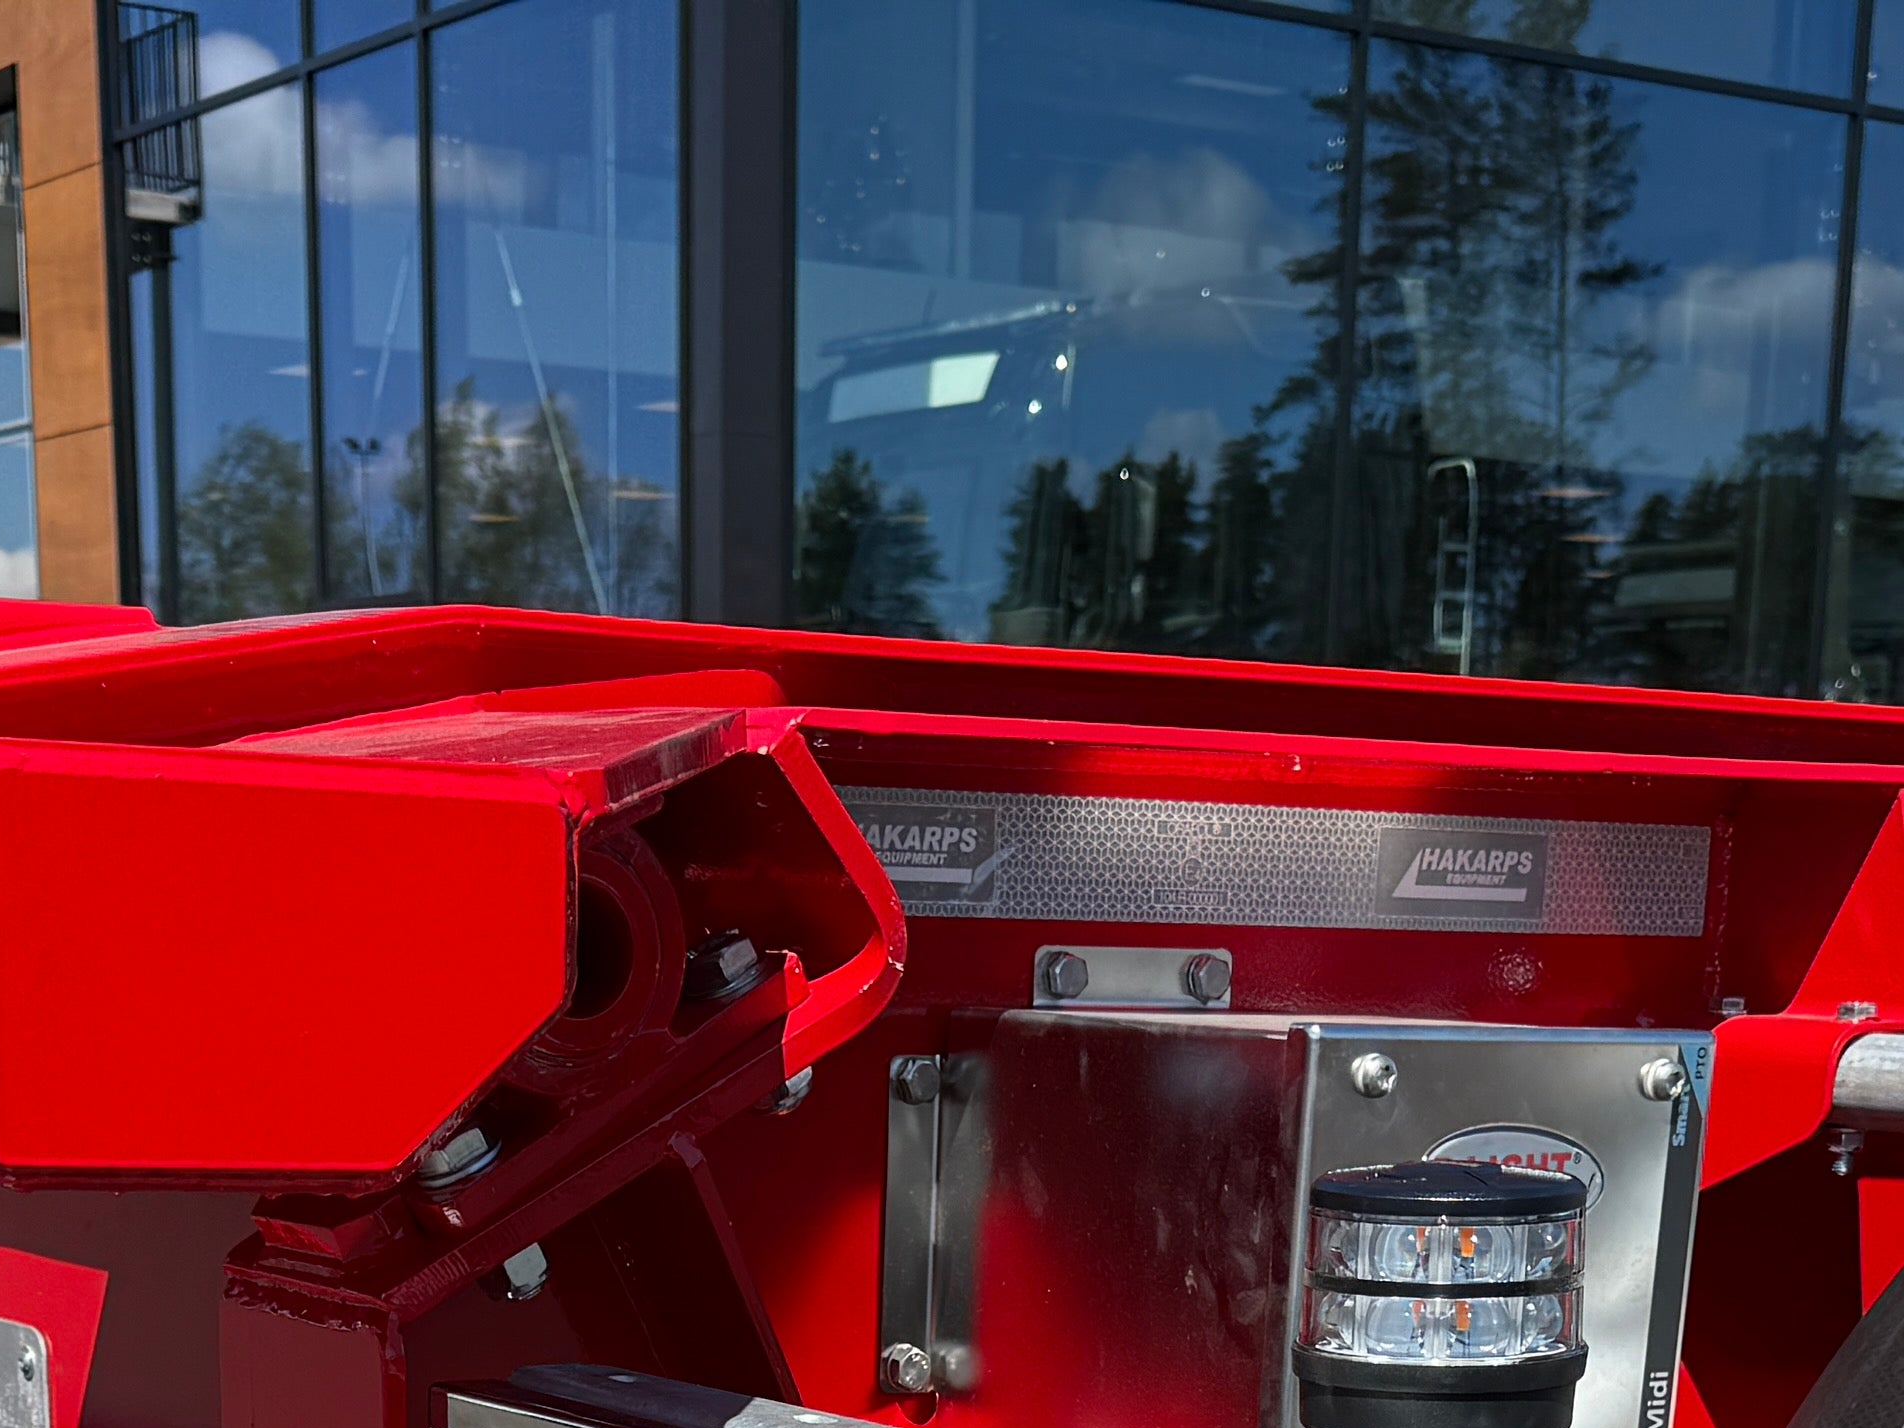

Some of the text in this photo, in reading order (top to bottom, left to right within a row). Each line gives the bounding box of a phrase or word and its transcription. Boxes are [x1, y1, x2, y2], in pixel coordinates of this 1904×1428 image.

[859, 823, 978, 853] AKARPS
[1421, 848, 1533, 875] HAKARPS
[1695, 1046, 1707, 1080] PTO
